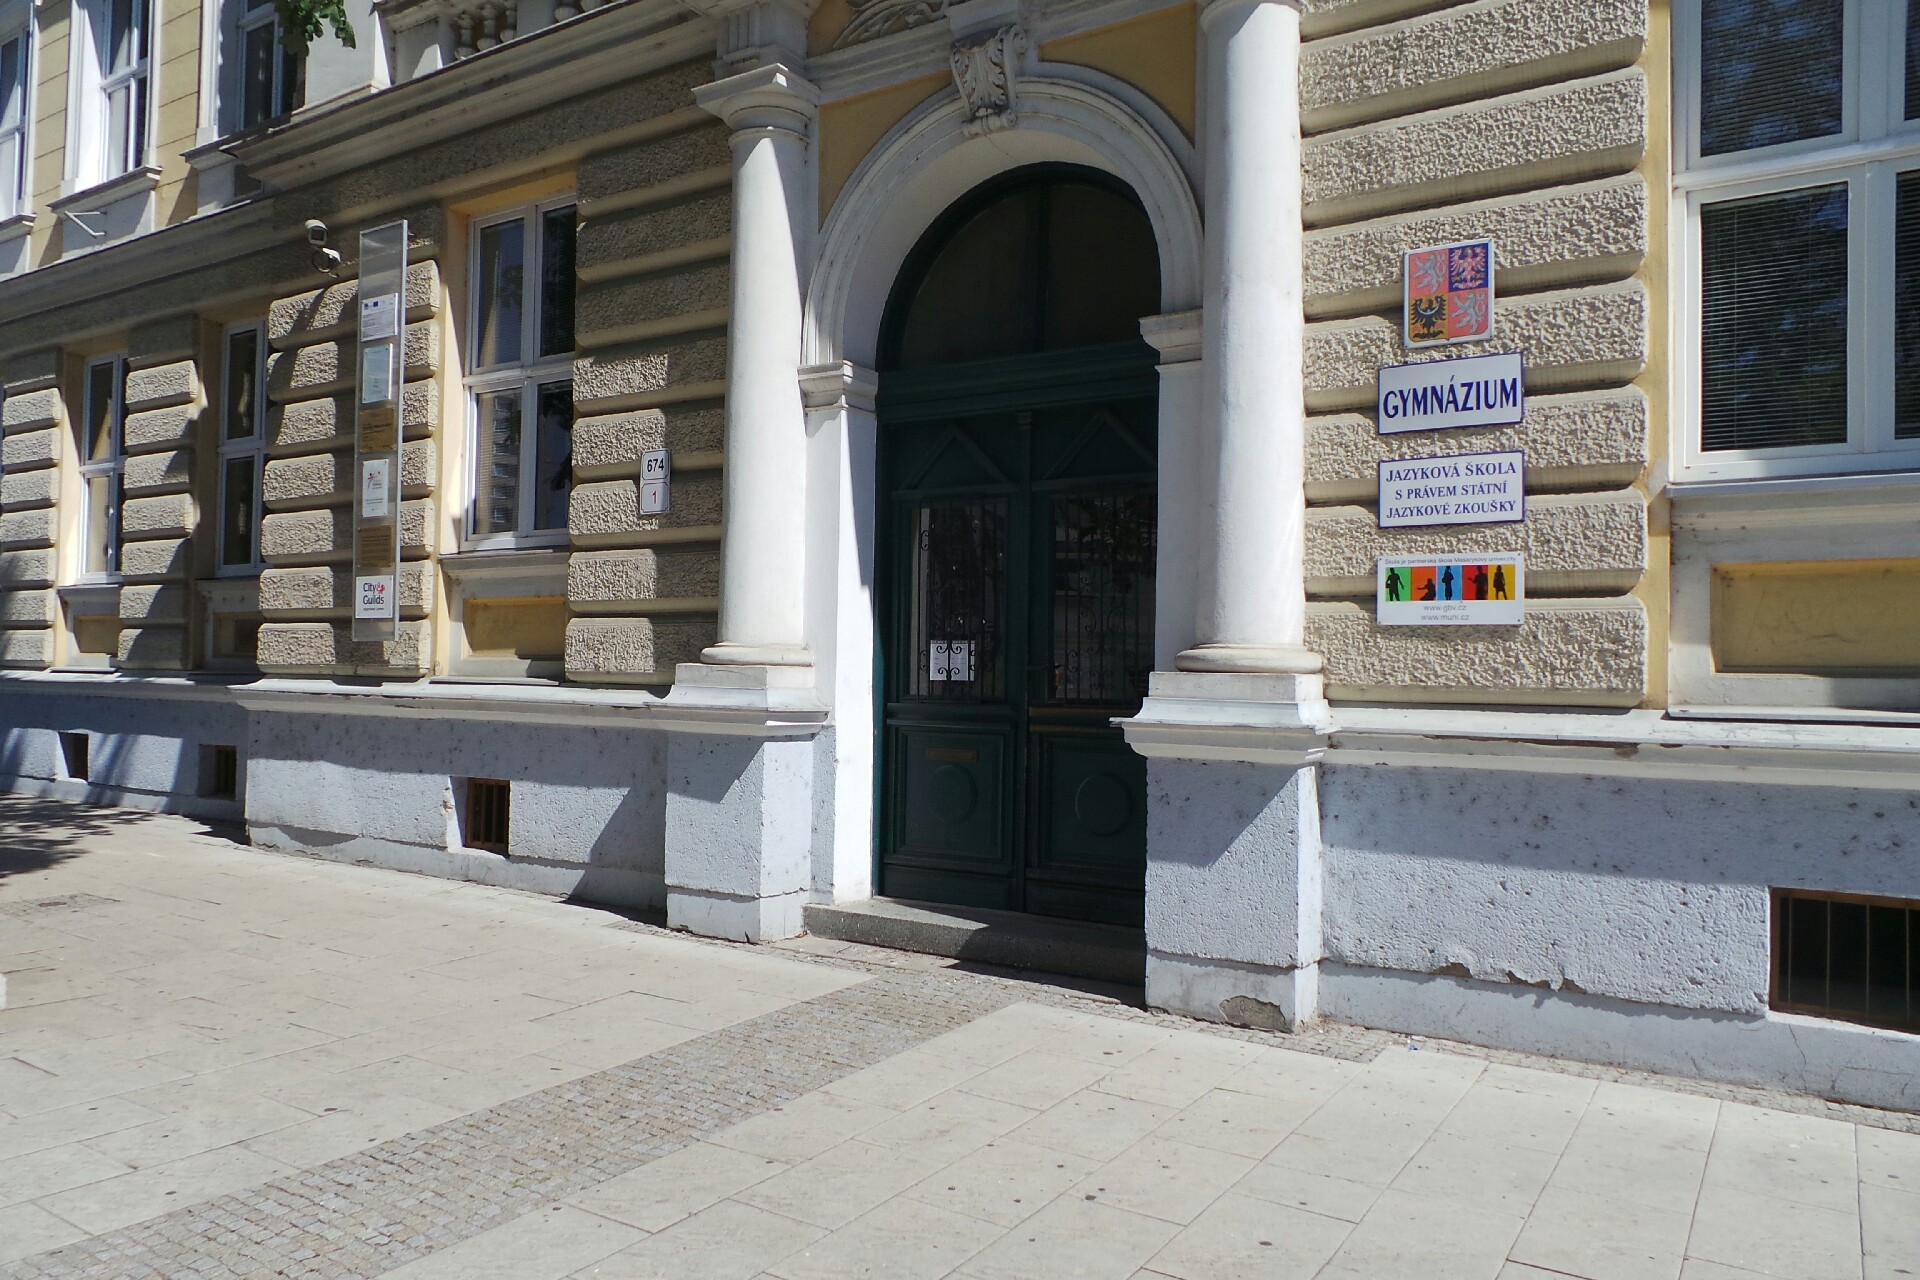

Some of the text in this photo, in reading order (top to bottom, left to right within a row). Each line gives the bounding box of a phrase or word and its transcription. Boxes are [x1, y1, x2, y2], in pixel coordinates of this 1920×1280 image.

[1383, 374, 1517, 419] GYMNÁZIUM
[647, 458, 664, 472] 674
[1386, 461, 1516, 482] JAZYKOVÁ ŠKOLA
[652, 490, 657, 504] 1
[1395, 480, 1508, 500] S PRÁVEM STÁTNÍ
[1386, 499, 1516, 519] JAZYKOVÉ ZKOUŠKY
[363, 582, 376, 594] City
[363, 594, 385, 605] Guilds
